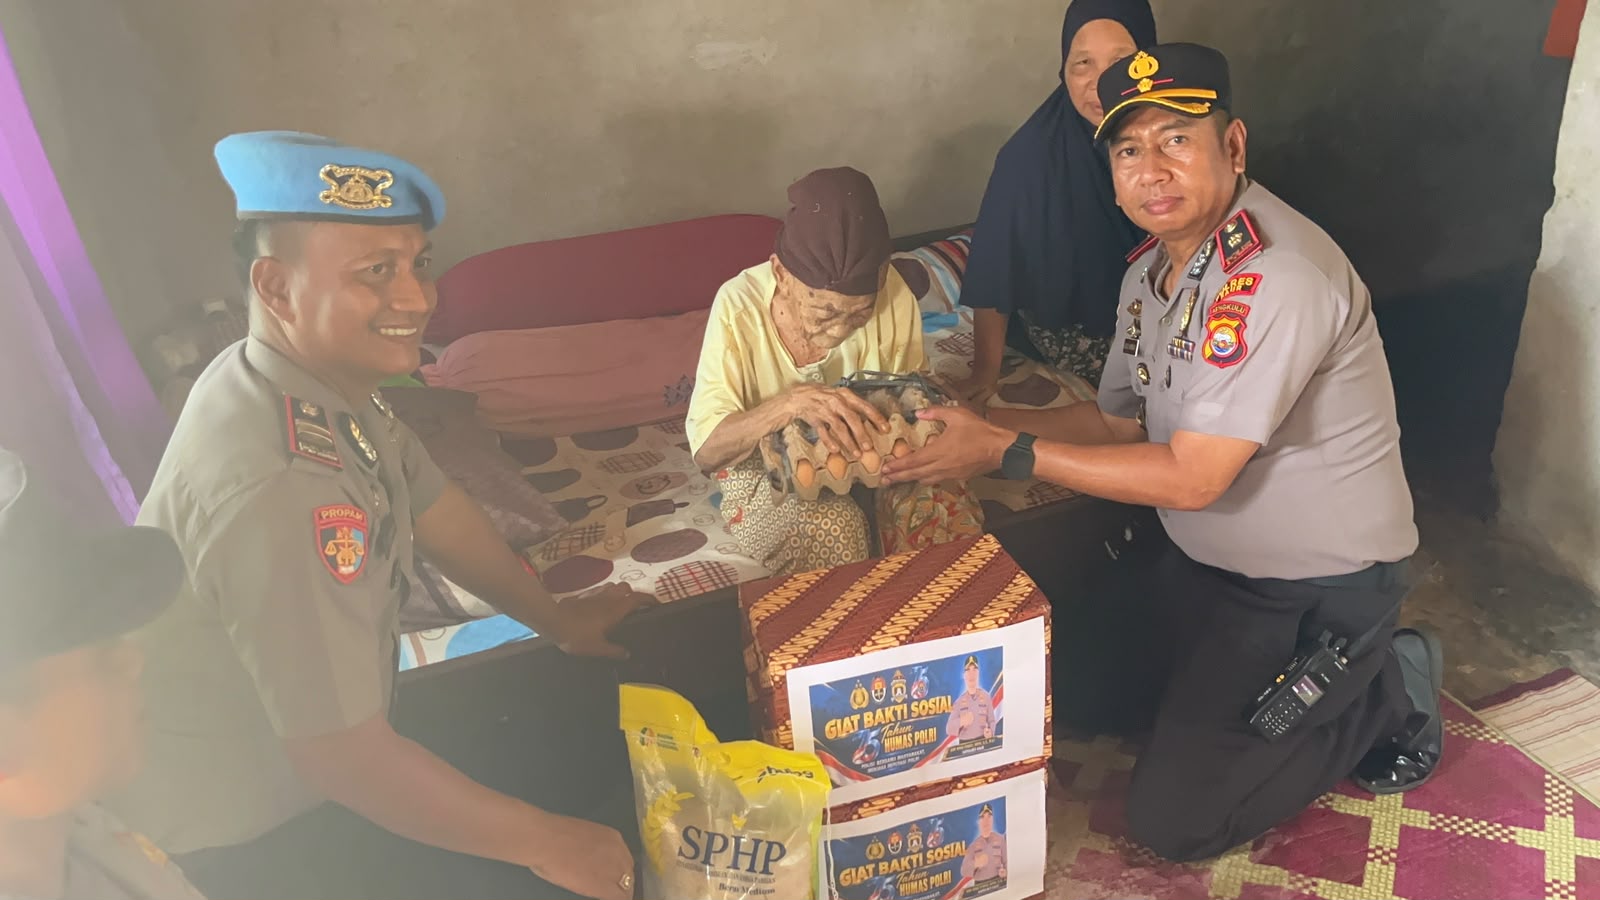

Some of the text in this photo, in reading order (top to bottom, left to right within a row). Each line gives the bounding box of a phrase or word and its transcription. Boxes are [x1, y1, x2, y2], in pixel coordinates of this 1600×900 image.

[321, 508, 364, 520] PROPAM
[825, 695, 953, 740] GIAT BAKTI SOSIAL
[881, 722, 913, 744] Tahun
[884, 732, 913, 753] HUMAS
[914, 727, 937, 746] POLRI
[678, 825, 786, 875] SPHP
[839, 840, 967, 887] GIAT BAKTI SOSIAL
[896, 869, 928, 889] Tahun
[900, 878, 928, 897] HUMAS
[930, 870, 952, 886] POLRI
